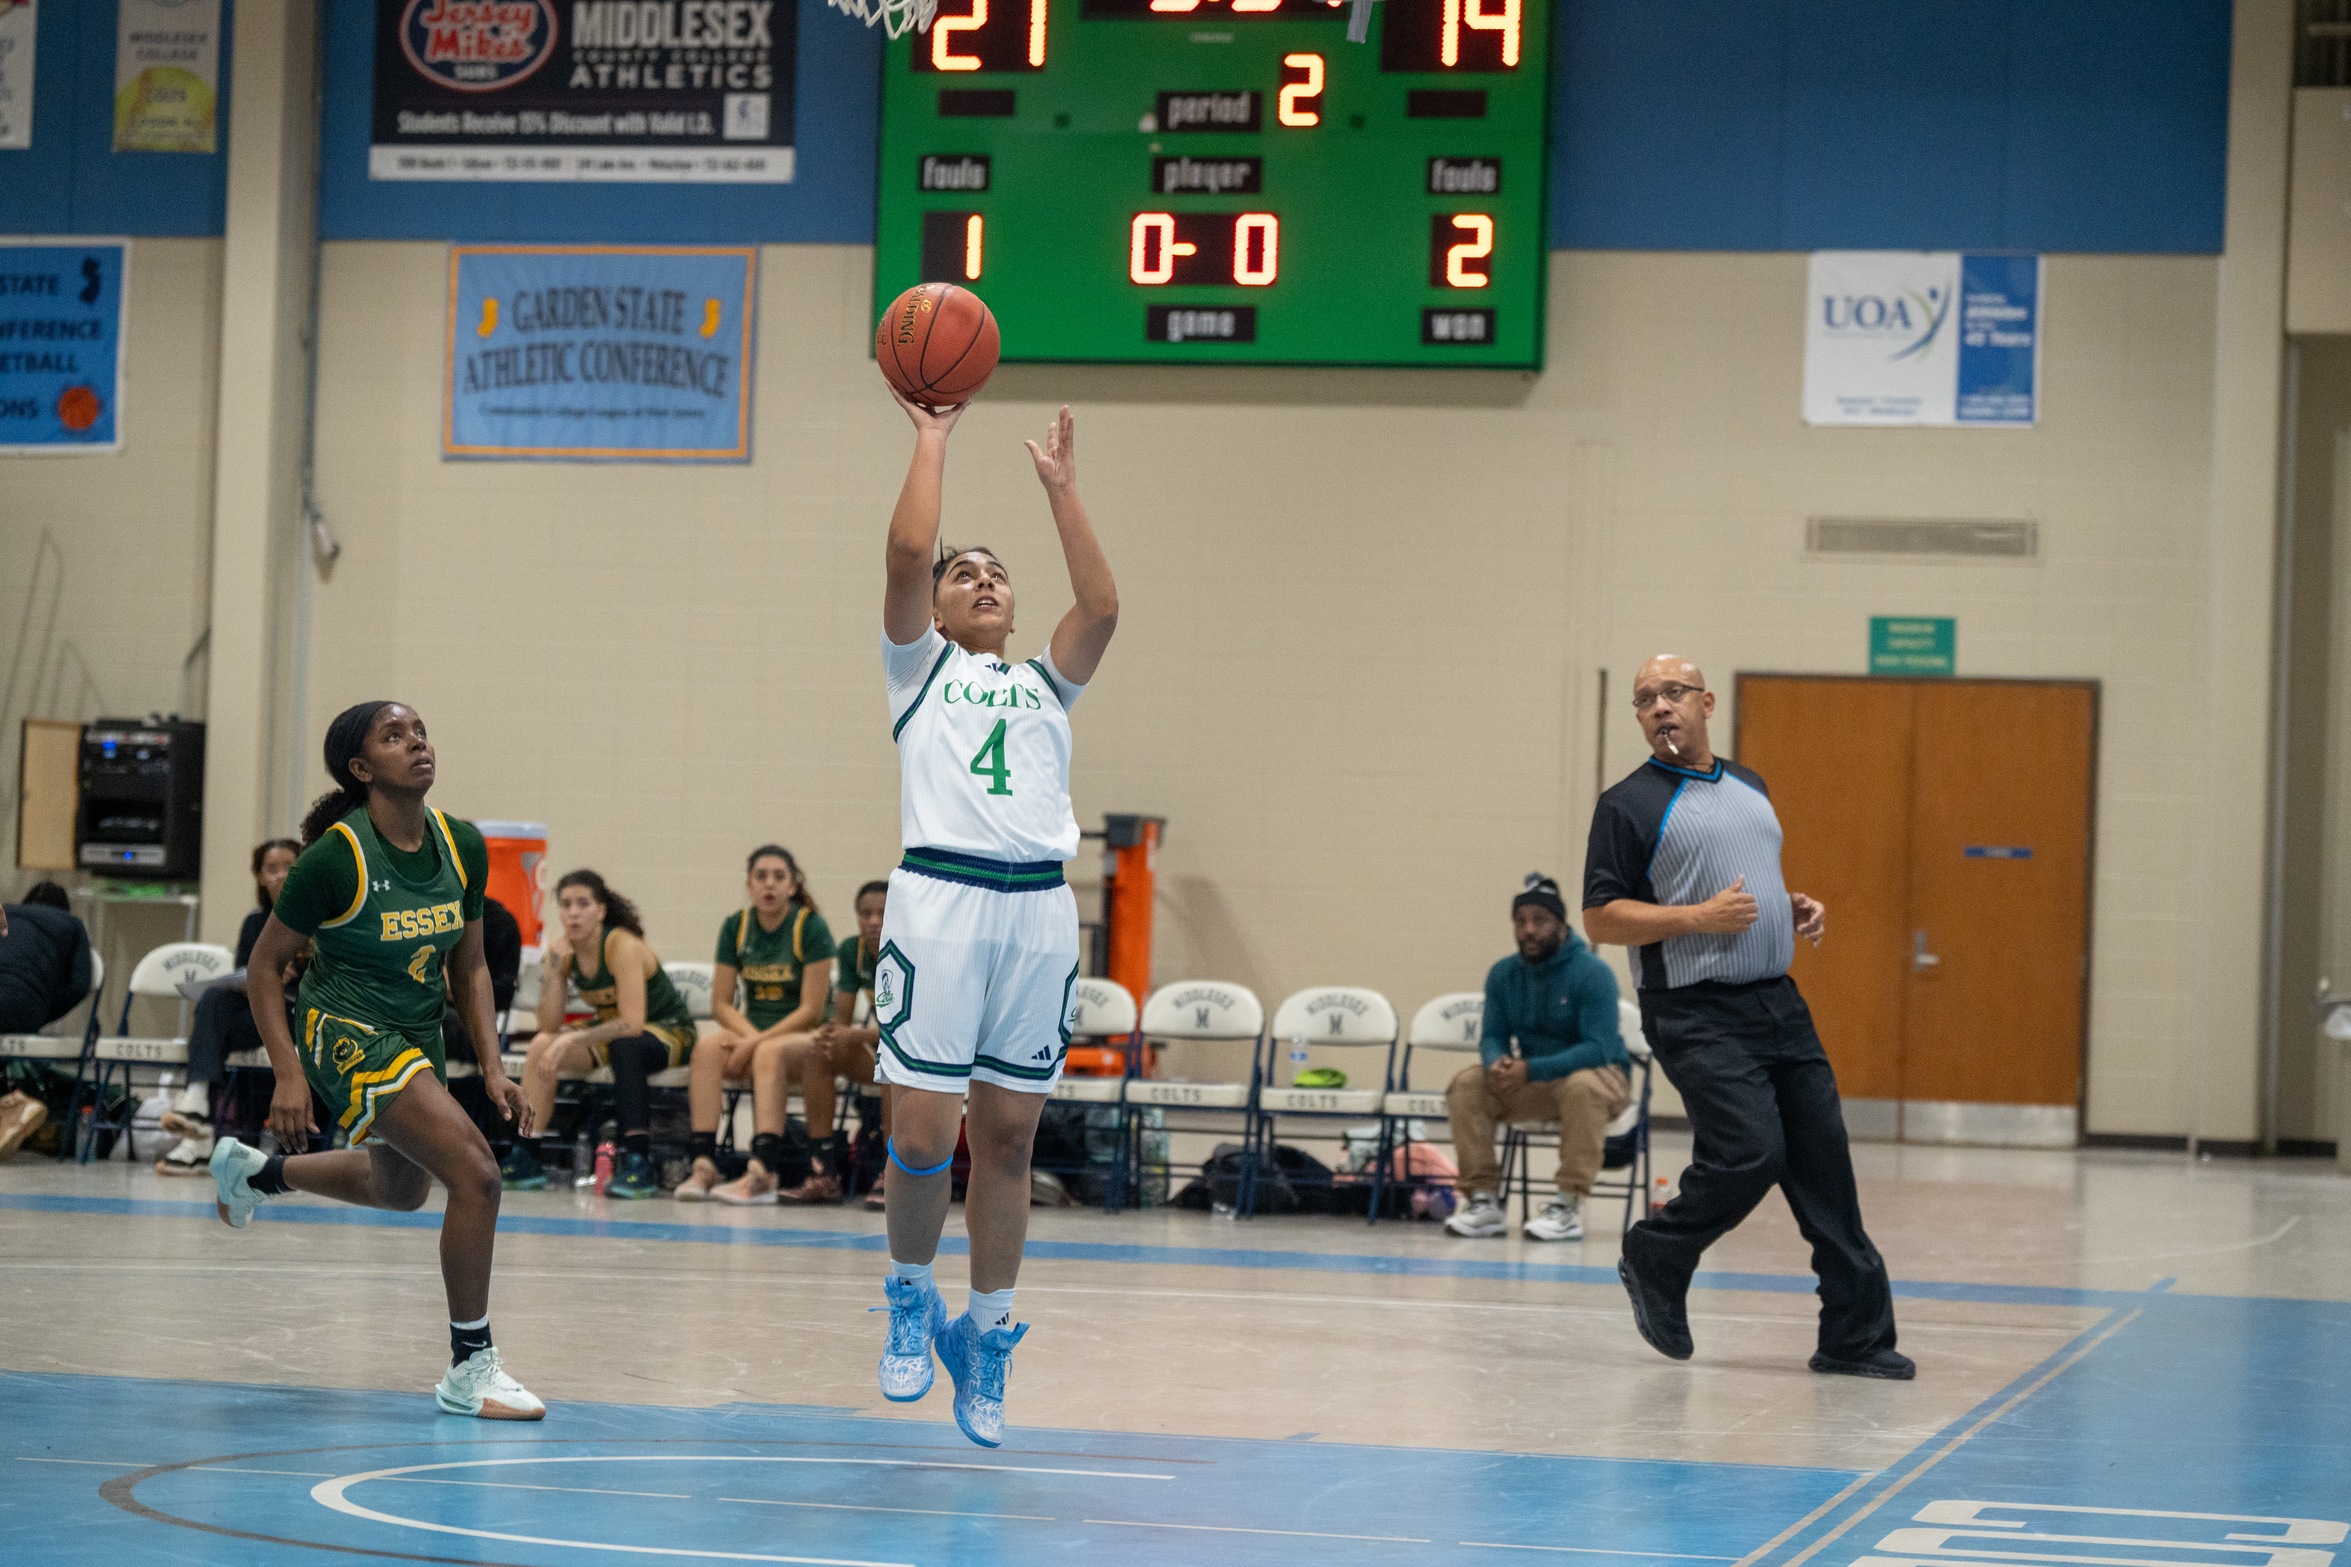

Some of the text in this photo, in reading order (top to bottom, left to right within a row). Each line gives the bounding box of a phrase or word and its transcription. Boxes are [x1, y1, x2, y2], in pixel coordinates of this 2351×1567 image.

[571, 1, 774, 48] MIDDLESEX
[569, 64, 774, 89] ATHLETICS
[1278, 53, 1325, 127] 2
[1167, 92, 1251, 128] period
[923, 158, 987, 189] fouls
[1163, 158, 1252, 193] player
[1430, 160, 1497, 192] fouls
[965, 214, 983, 280] 1
[1446, 213, 1494, 288] 2
[512, 285, 688, 335] GARDEN STATE
[1166, 308, 1235, 342] game
[1431, 312, 1486, 341] won
[1823, 296, 1912, 330] UOA
[463, 340, 730, 398] ATHLETIC CONFERENCE
[944, 679, 1042, 710] COLTS
[970, 718, 1013, 796] 4
[381, 900, 464, 941] ESSEX
[116, 1043, 162, 1058] COLTS
[1151, 1088, 1201, 1102] COLTS
[1286, 1095, 1339, 1109] COLTS
